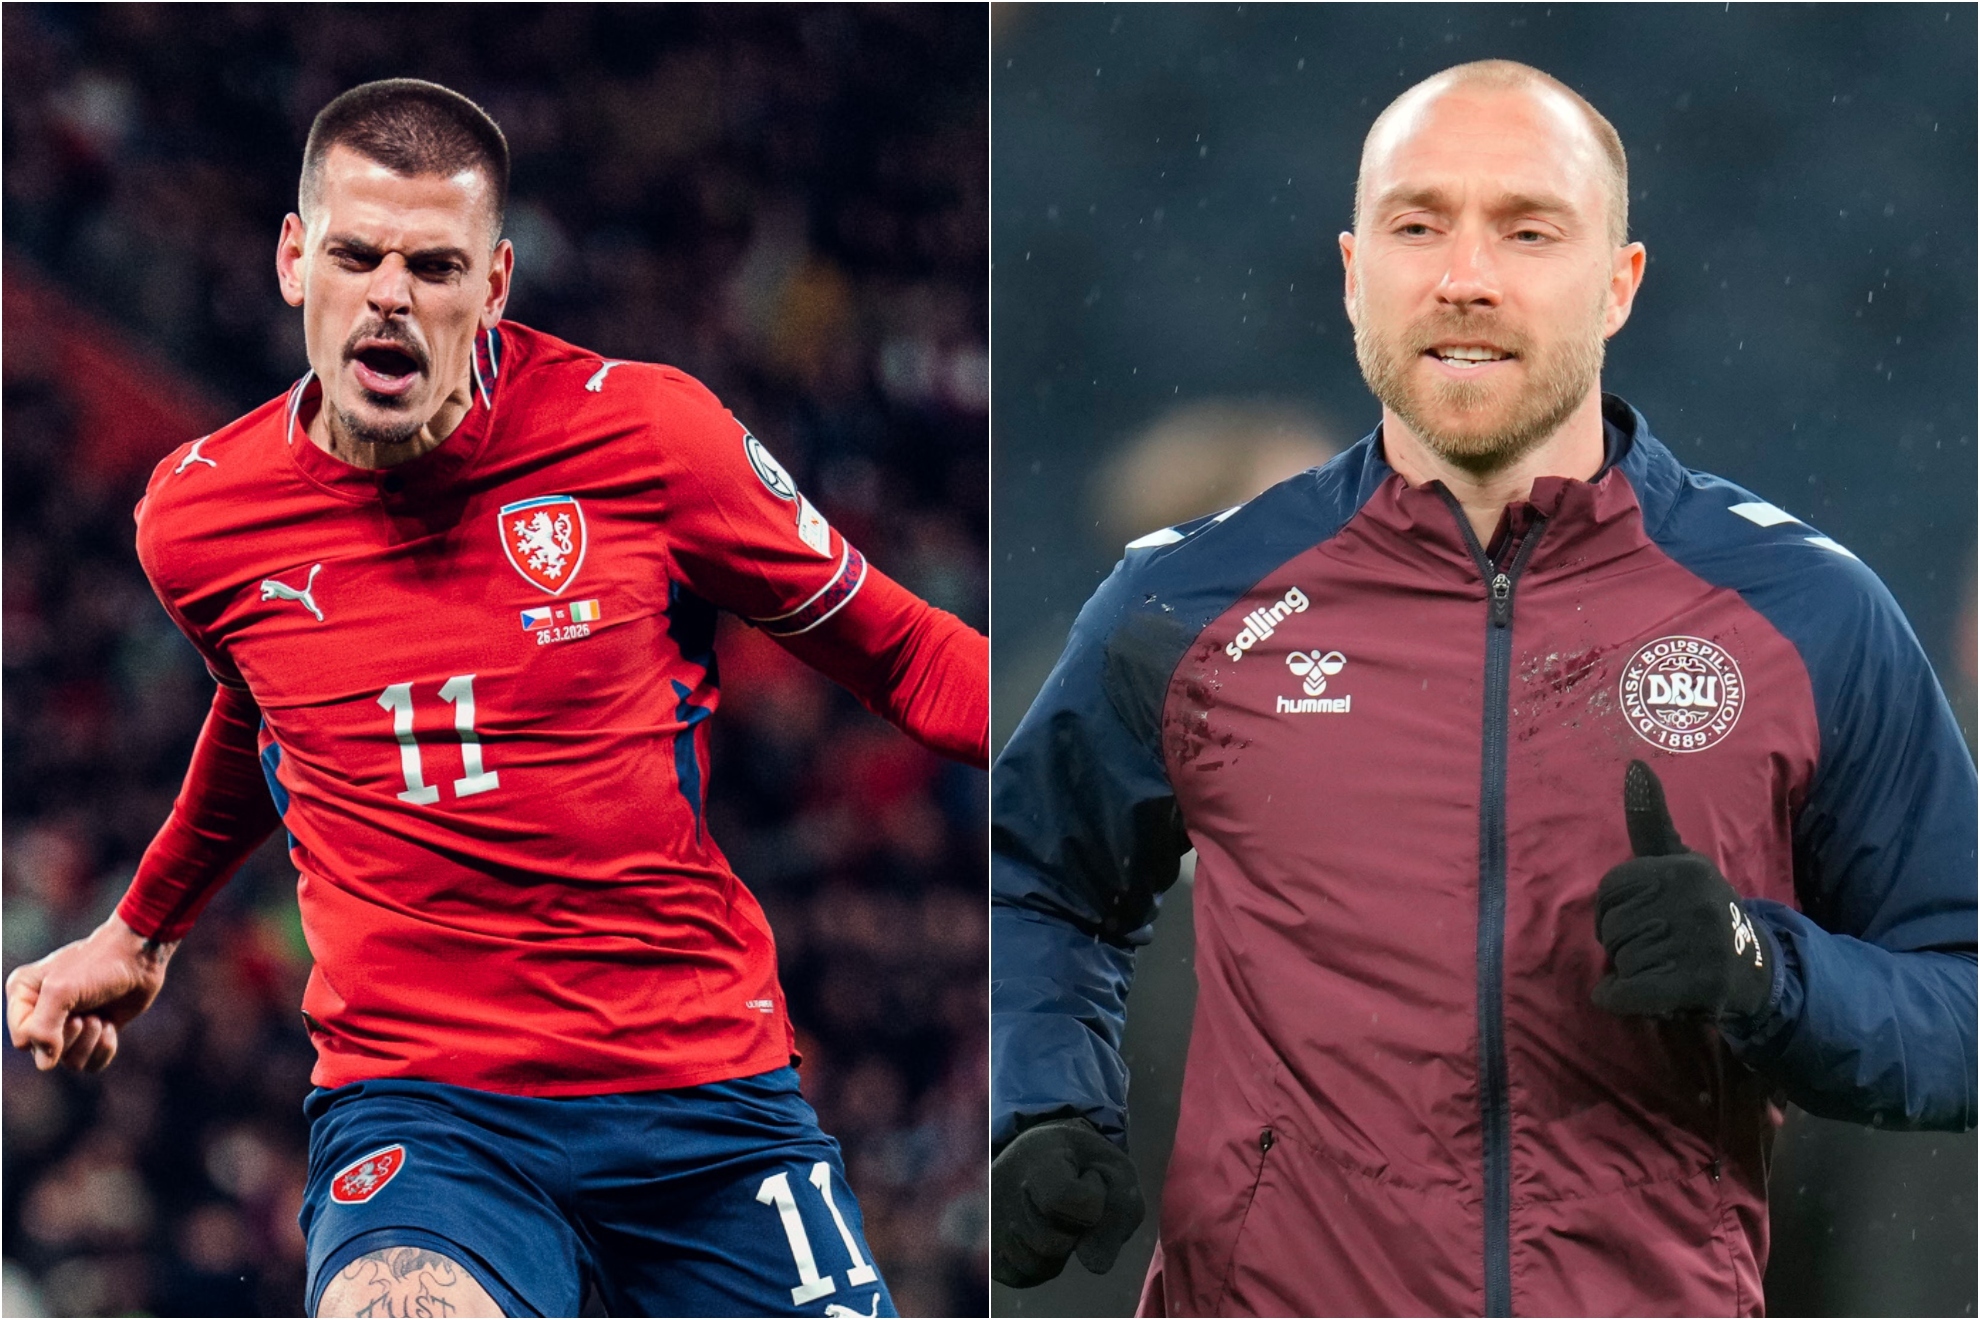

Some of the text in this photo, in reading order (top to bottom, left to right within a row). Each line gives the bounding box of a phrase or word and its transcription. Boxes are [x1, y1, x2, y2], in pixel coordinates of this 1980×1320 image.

[536, 623, 591, 646] 26.3.2026
[1226, 587, 1310, 662] salling
[1277, 695, 1352, 713] hummel
[1625, 667, 1653, 733] DANSK
[1712, 673, 1739, 735] UNION
[1647, 673, 1718, 707] DBU
[376, 674, 500, 805] 11
[1658, 731, 1706, 748] 1889
[755, 1161, 878, 1306] 11
